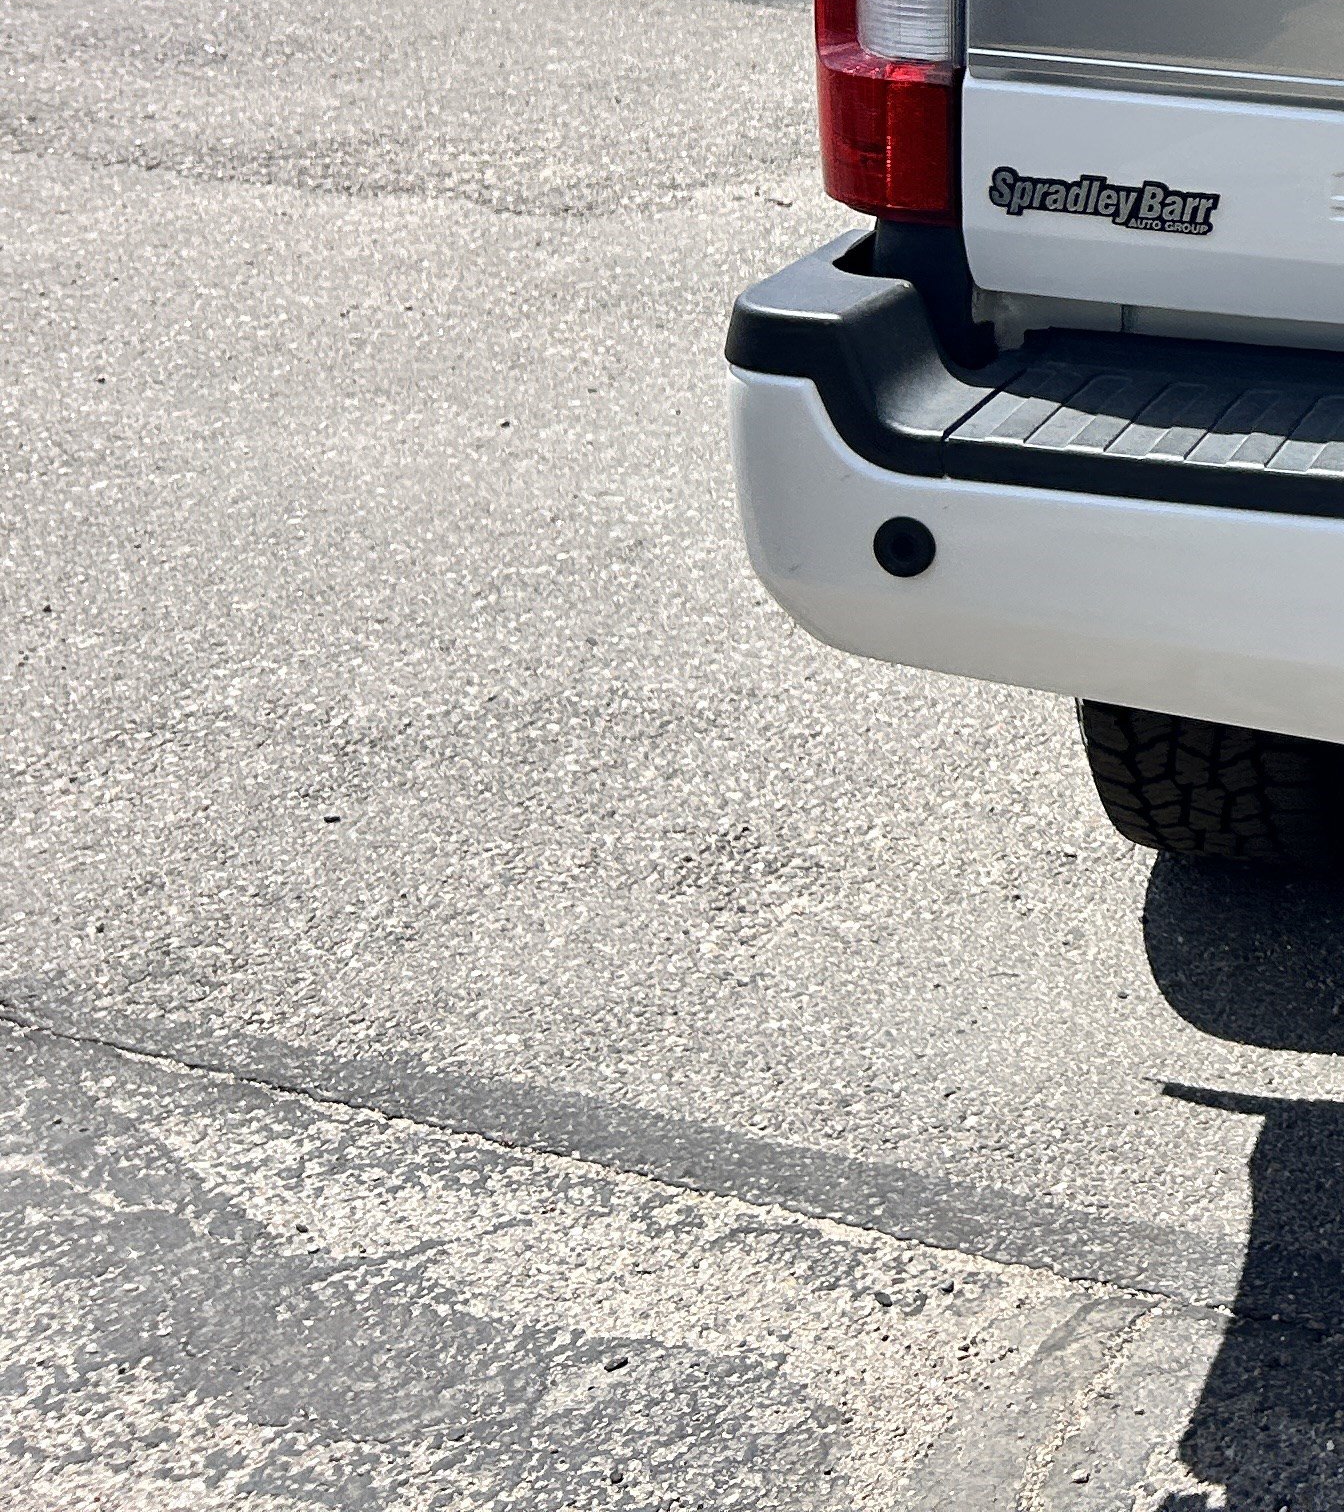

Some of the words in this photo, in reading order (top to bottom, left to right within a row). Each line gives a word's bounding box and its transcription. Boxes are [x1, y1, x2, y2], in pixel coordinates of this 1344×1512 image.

[990, 168, 1137, 224] Spradley
[1138, 184, 1216, 224] Barr
[1128, 218, 1162, 231] AUTO
[1164, 220, 1209, 234] GROUP
